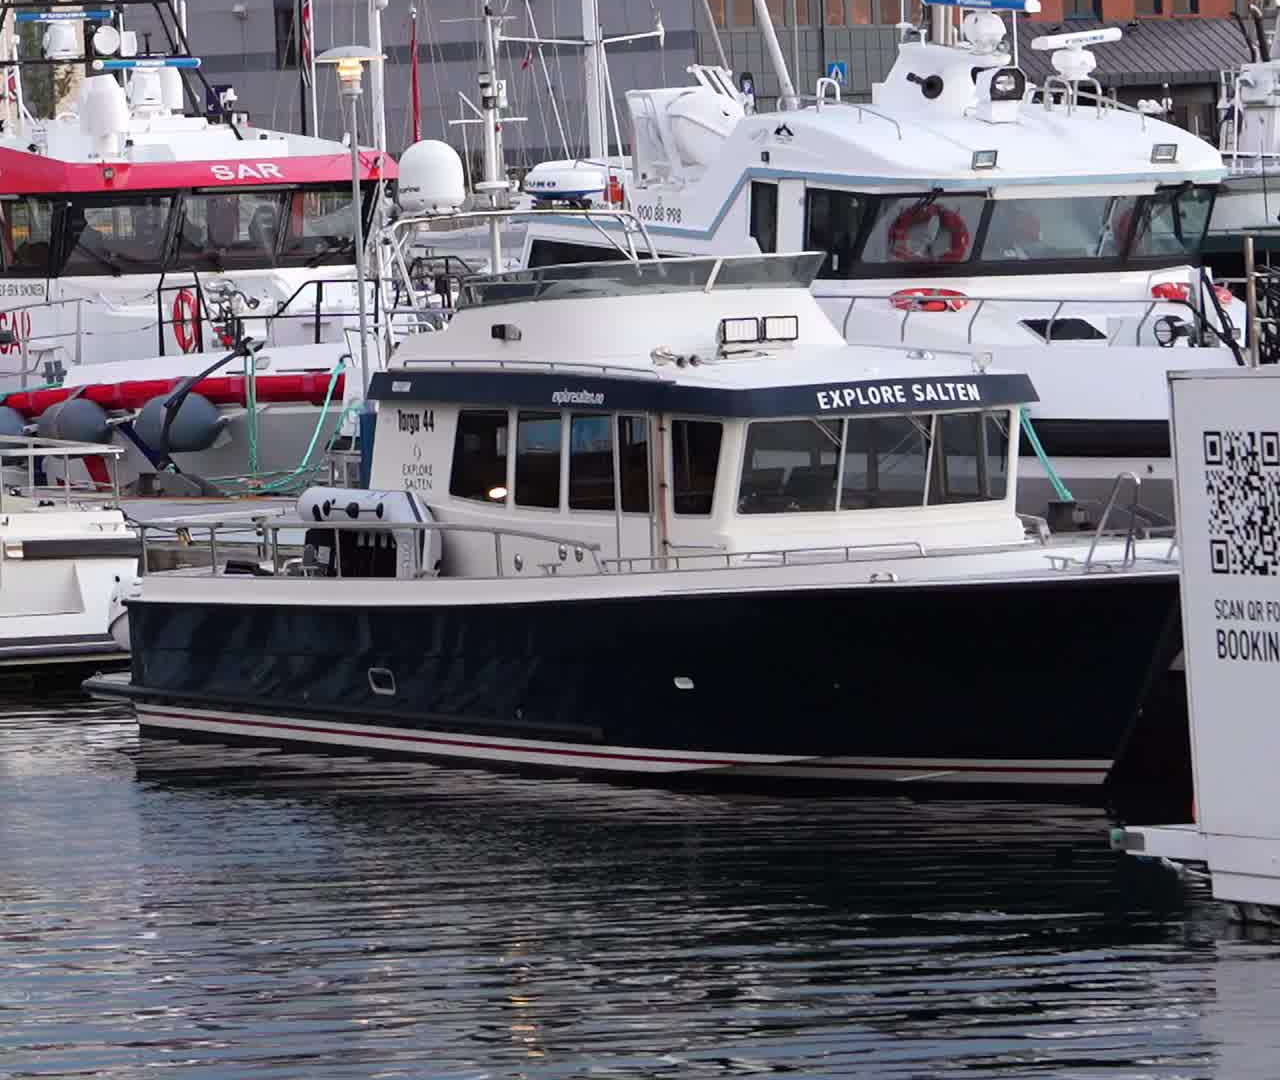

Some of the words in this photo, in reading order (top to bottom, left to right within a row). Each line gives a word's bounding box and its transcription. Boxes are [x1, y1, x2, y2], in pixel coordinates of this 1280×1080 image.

[209, 162, 285, 181] SAR
[816, 385, 907, 410] EXPLORE
[911, 383, 981, 402] SALTEN
[397, 408, 420, 435] Targa
[422, 409, 435, 433] 44
[402, 463, 433, 477] EXPLORE
[403, 478, 433, 490] SALTEN
[1214, 599, 1245, 621] SCAN
[1247, 600, 1264, 622] QR
[1216, 628, 1280, 662] BOOKIN
